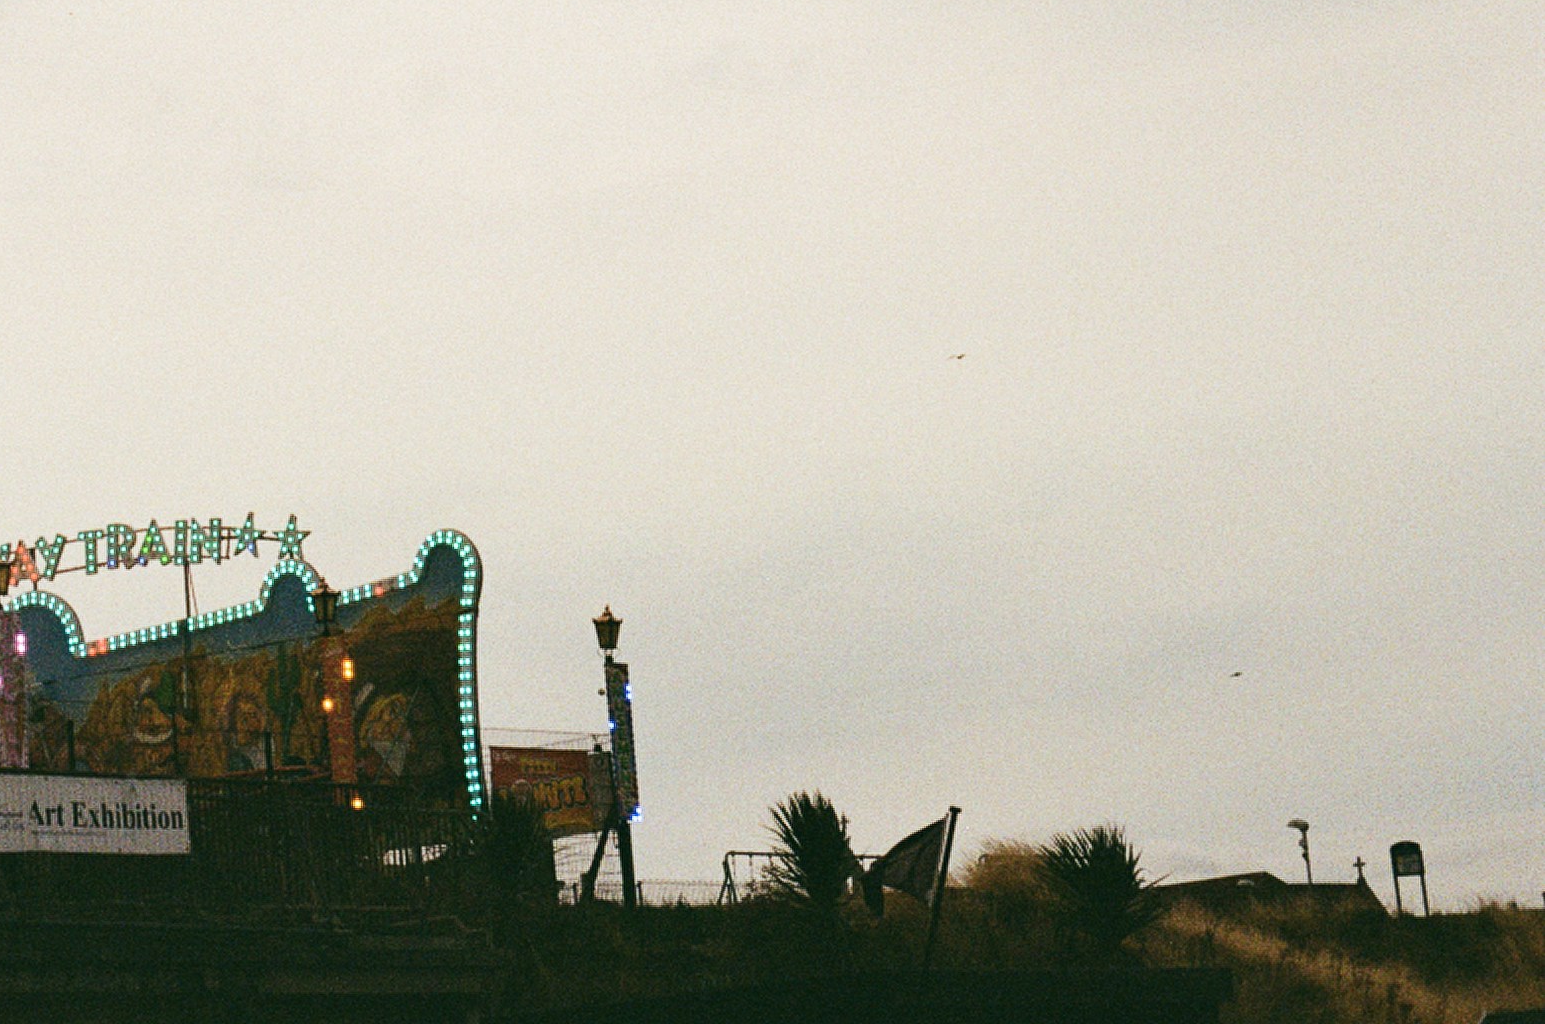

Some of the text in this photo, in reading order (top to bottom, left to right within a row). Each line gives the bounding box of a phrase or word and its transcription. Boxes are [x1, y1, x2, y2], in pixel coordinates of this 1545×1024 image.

[78, 517, 222, 576] TRAIN
[30, 799, 65, 826] Art
[72, 800, 185, 830] Exhibition
